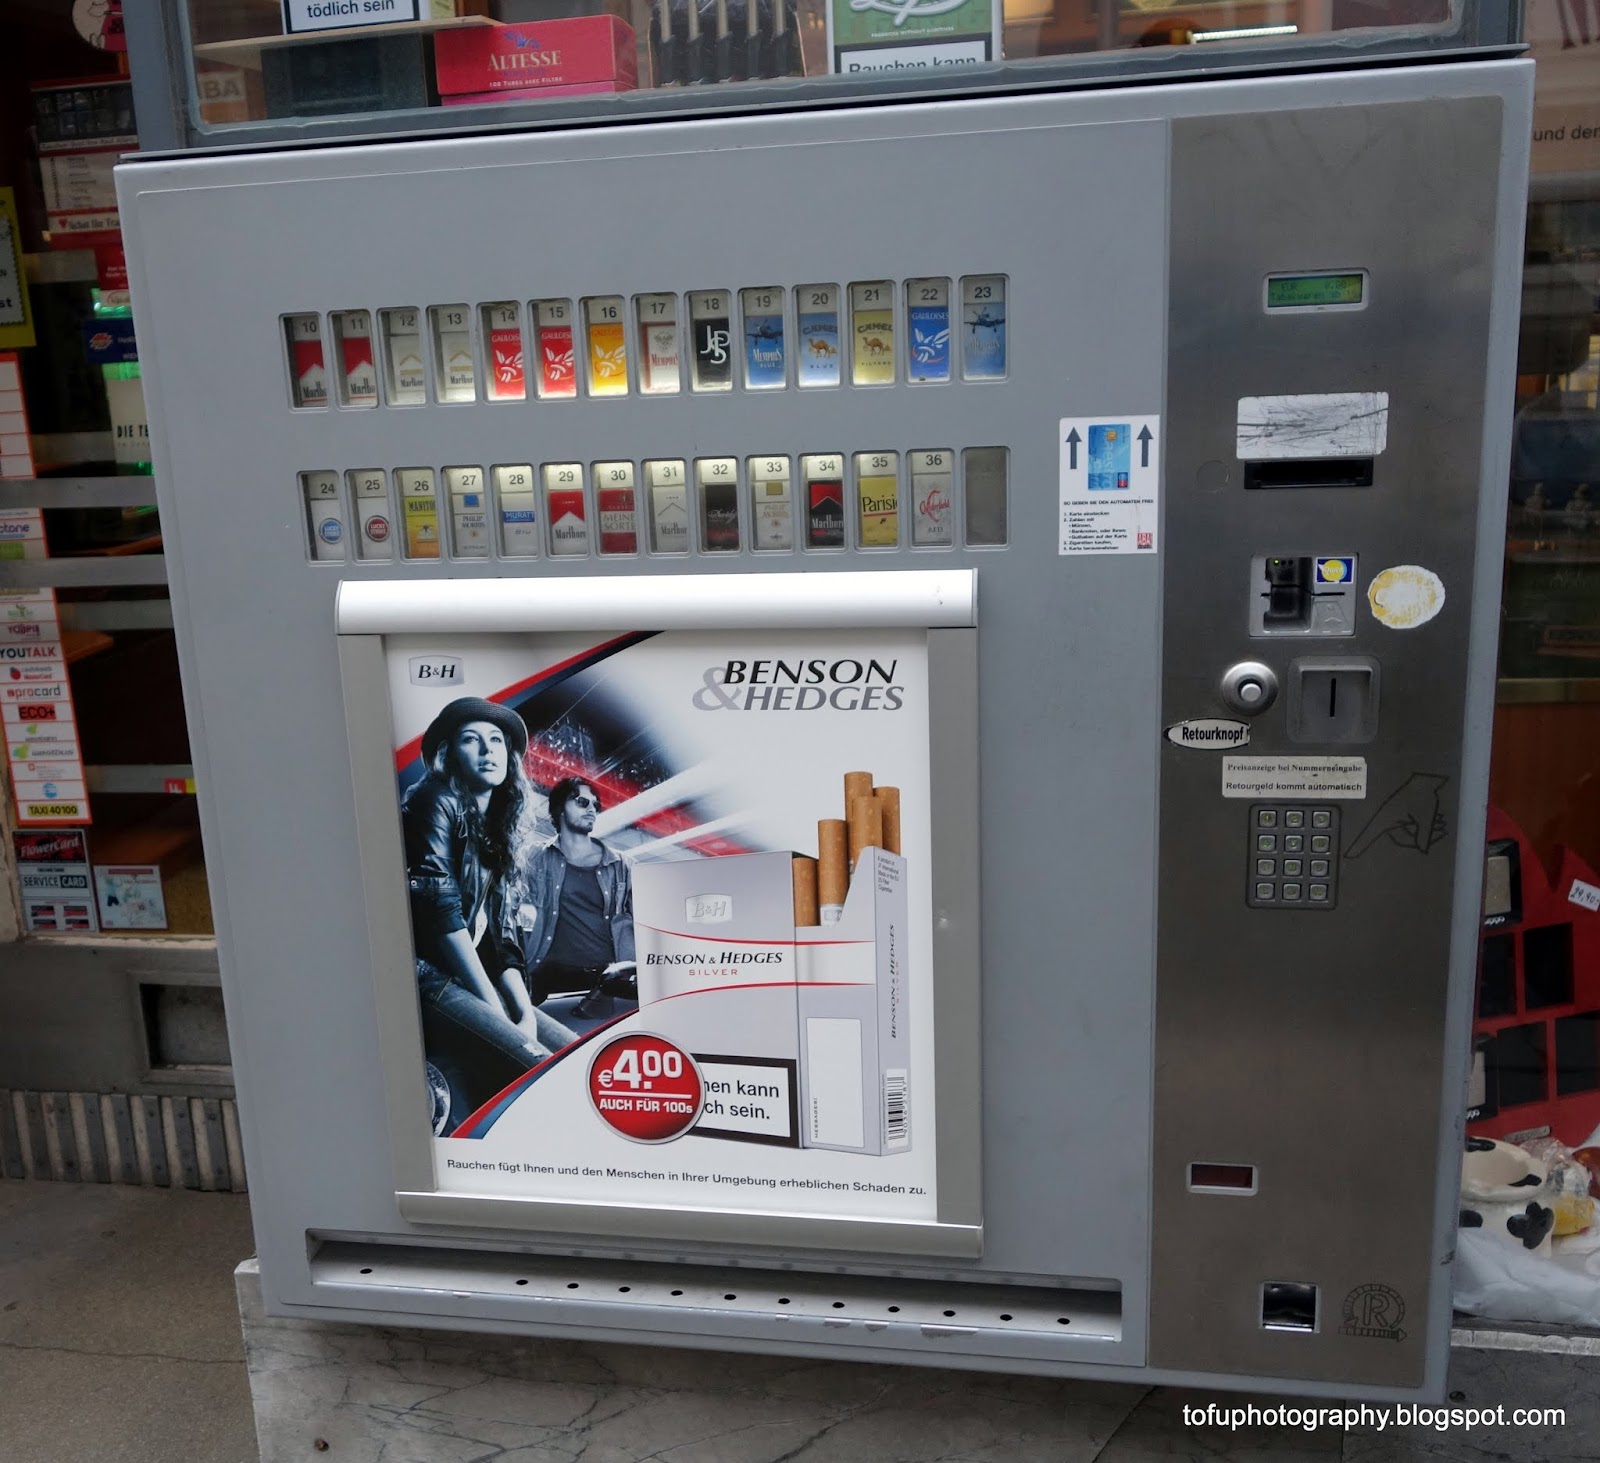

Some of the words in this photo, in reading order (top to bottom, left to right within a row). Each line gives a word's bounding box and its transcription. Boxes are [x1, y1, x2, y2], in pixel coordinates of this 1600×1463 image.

[307, 2, 359, 18] tödlich
[363, 0, 395, 12] sein
[488, 50, 562, 72] ALTESSE
[812, 293, 829, 305] 20
[864, 289, 880, 301] 21
[921, 288, 938, 300] 22
[974, 287, 992, 299] 23
[704, 298, 720, 310] 18
[755, 296, 771, 308] 19
[549, 307, 564, 318] 15
[602, 307, 617, 318] 16
[651, 303, 666, 314] 17
[401, 315, 415, 327] 12
[447, 313, 462, 325] 13
[501, 311, 516, 322] 14
[302, 321, 317, 333] 10
[351, 318, 364, 330] 11
[820, 460, 836, 471] 34
[872, 456, 888, 468] 35
[926, 454, 943, 466] 36
[663, 466, 678, 478] 31
[712, 464, 728, 475] 32
[766, 461, 783, 472] 33
[462, 475, 476, 486] 27
[509, 474, 525, 485] 28
[559, 471, 574, 482] 29
[611, 469, 626, 481] 30
[320, 483, 336, 494] 24
[365, 480, 380, 490] 25
[414, 481, 429, 491] 26
[418, 664, 456, 678] B&H
[723, 659, 897, 684] BENSON
[743, 686, 905, 711] HEDGES
[19, 706, 55, 719] ECO+
[1182, 727, 1243, 743] Retourknopf
[1228, 764, 1276, 773] Preisanzeige
[1278, 763, 1289, 771] bei
[1291, 763, 1362, 772] Nummerneingabe
[1226, 782, 1273, 790] Retourgeld
[1276, 782, 1306, 790] kommt
[1308, 782, 1362, 791] automatisch
[29, 806, 48, 814] TAXI
[24, 876, 59, 887] SERVICE
[62, 876, 86, 887] CARD
[646, 953, 706, 965] BENSON
[720, 952, 783, 964] HEDGES
[689, 968, 738, 976] SILVER
[737, 1080, 780, 1098] kann
[600, 1098, 633, 1110] AUCH
[636, 1098, 660, 1112] FÜR
[730, 1104, 771, 1120] sein.
[447, 1159, 496, 1171] Rauchen
[498, 1162, 520, 1173] fügt
[524, 1163, 554, 1174] Ihnen
[557, 1166, 579, 1175] und
[582, 1167, 603, 1177] den
[606, 1168, 665, 1180] Menschen
[668, 1172, 678, 1181] in
[682, 1172, 709, 1182] Ihrer
[712, 1174, 776, 1188] Umgebung
[780, 1178, 849, 1191] erheblichen
[853, 1182, 905, 1194] Schaden
[909, 1186, 927, 1195] zu.
